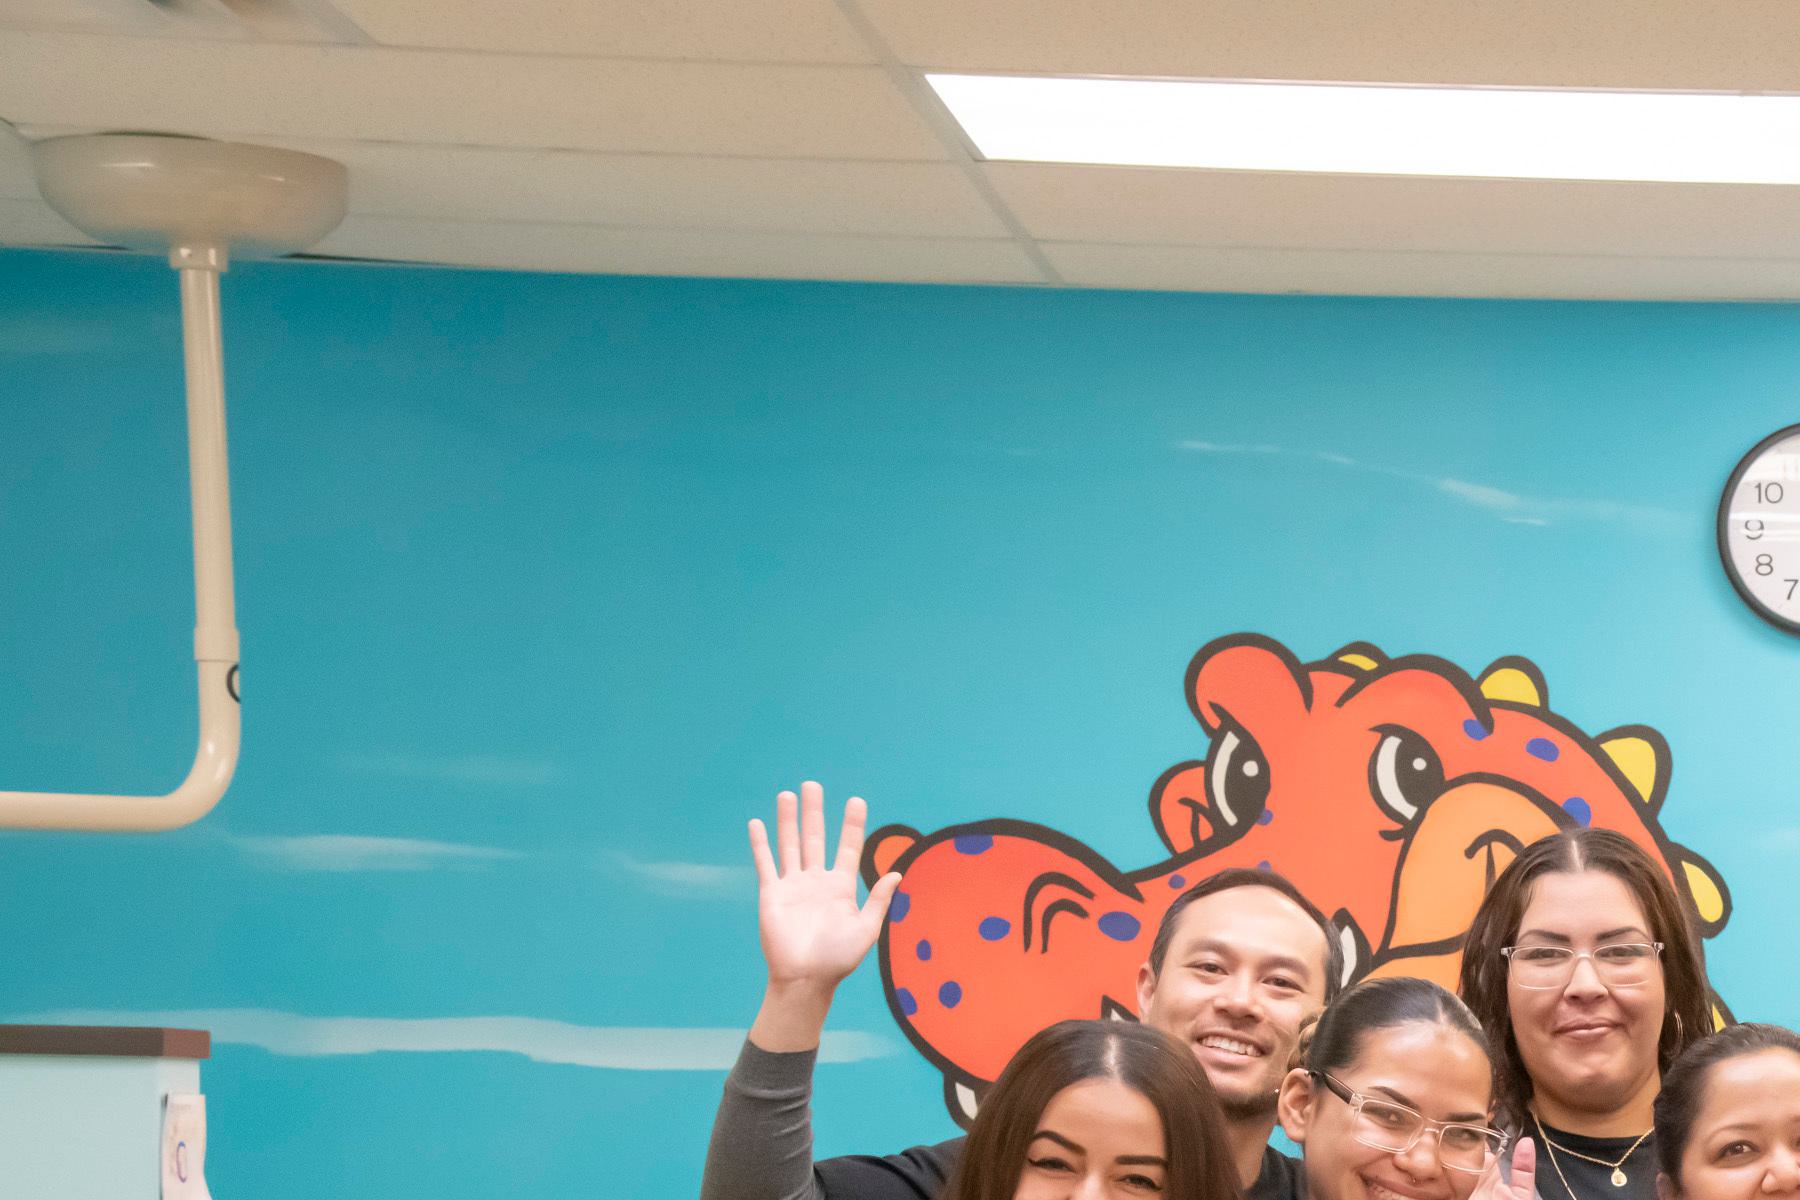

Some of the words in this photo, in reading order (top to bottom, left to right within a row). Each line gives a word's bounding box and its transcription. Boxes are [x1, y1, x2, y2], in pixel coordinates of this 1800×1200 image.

[1755, 482, 1783, 504] 10
[1744, 519, 1764, 540] 9
[1755, 553, 1774, 576] 8
[1784, 579, 1799, 600] 7
